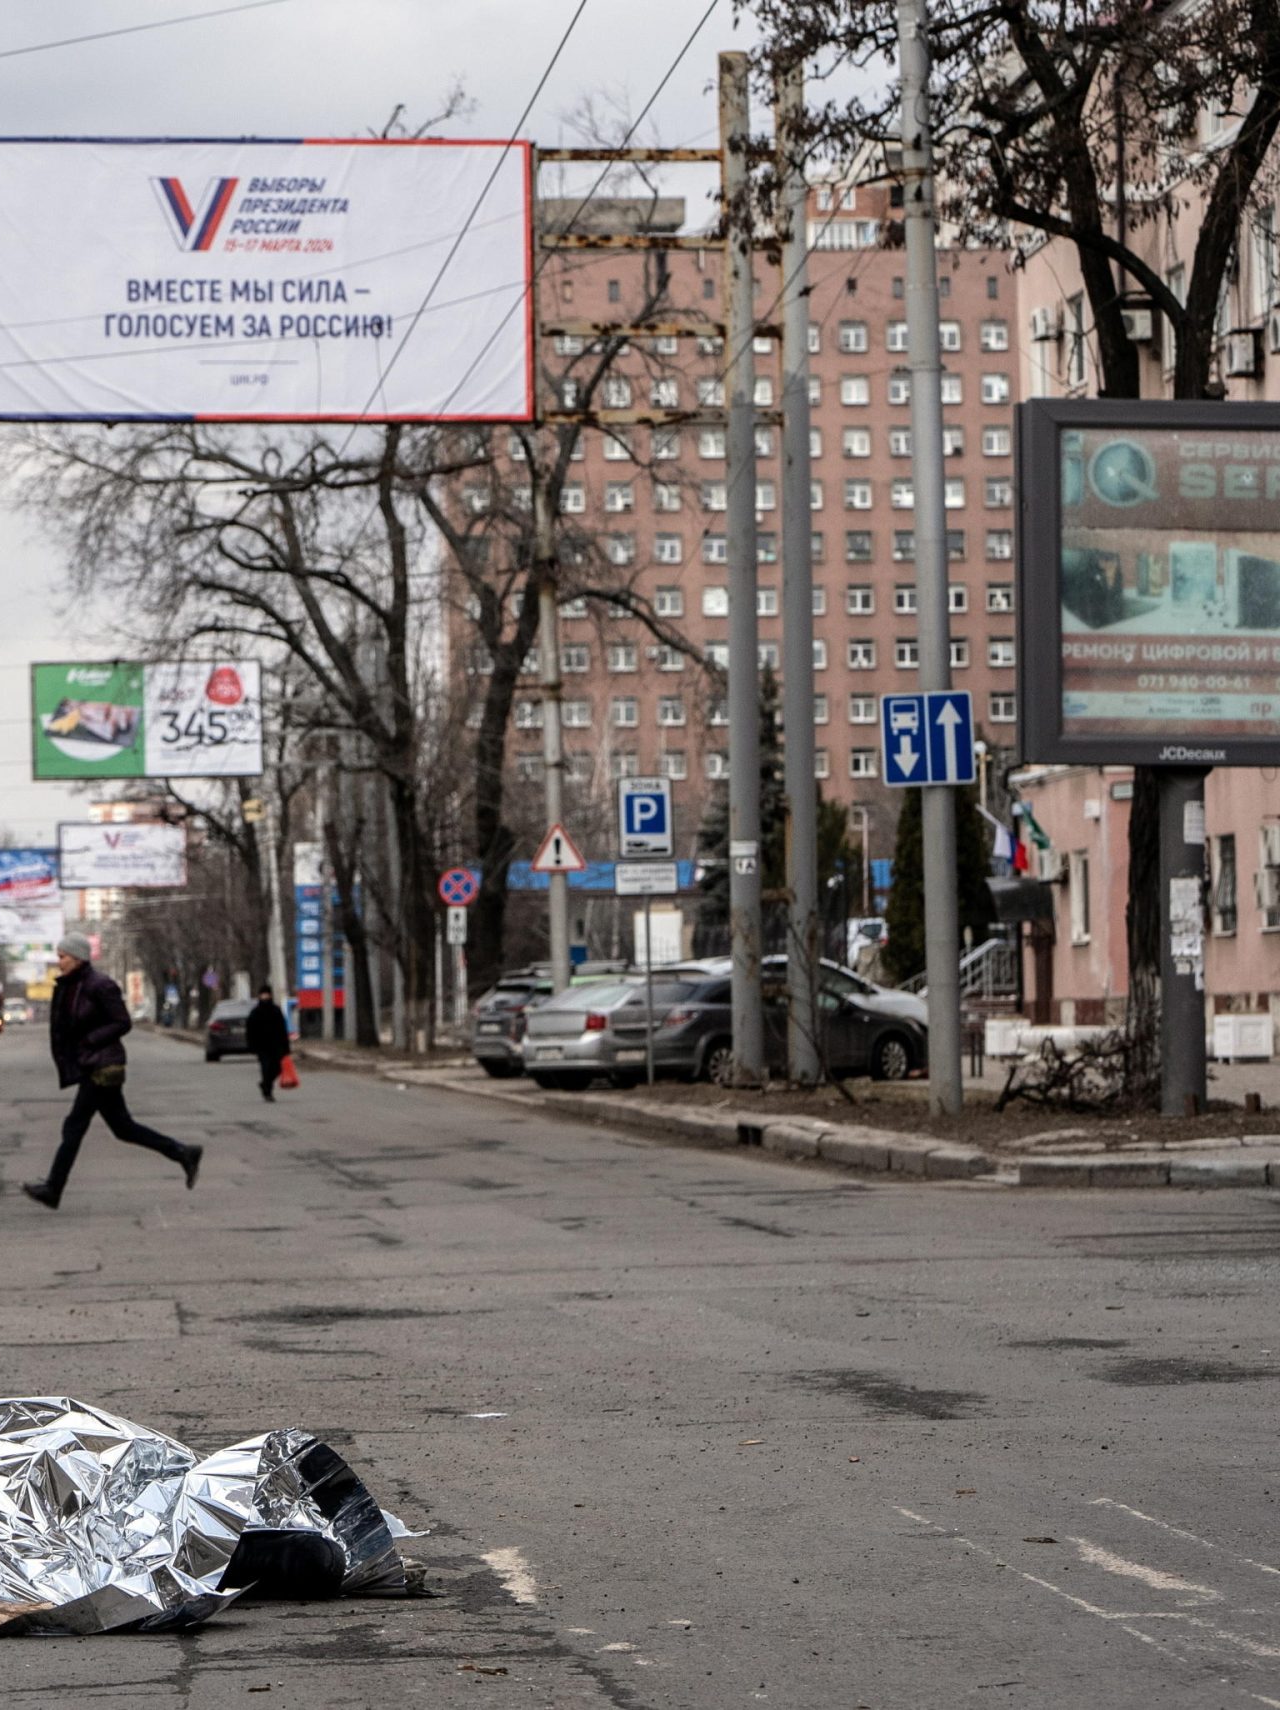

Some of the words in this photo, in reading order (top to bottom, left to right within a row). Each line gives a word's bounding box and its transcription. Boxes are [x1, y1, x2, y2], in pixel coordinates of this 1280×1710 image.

[247, 177, 326, 193] ВЫБОРЫ
[238, 198, 350, 215] ПРЕЗИДЕНТА
[229, 219, 301, 235] РОССИИ
[260, 239, 301, 252] МАРТА
[303, 239, 334, 252] 2024
[126, 279, 222, 303] ВМЕСТЕ
[230, 280, 274, 303] МЫ
[281, 280, 348, 303] СИЛА
[104, 313, 235, 338] ГОЛОСУЕМ
[242, 314, 272, 338] ЗА
[279, 314, 393, 339] РОССИЮ!
[1062, 644, 1137, 661] РЕМОНТ
[1141, 642, 1250, 662] ЦИФРОВОЙ
[160, 711, 228, 744] 345
[1159, 746, 1227, 761] JCDecaux
[633, 796, 658, 832] P
